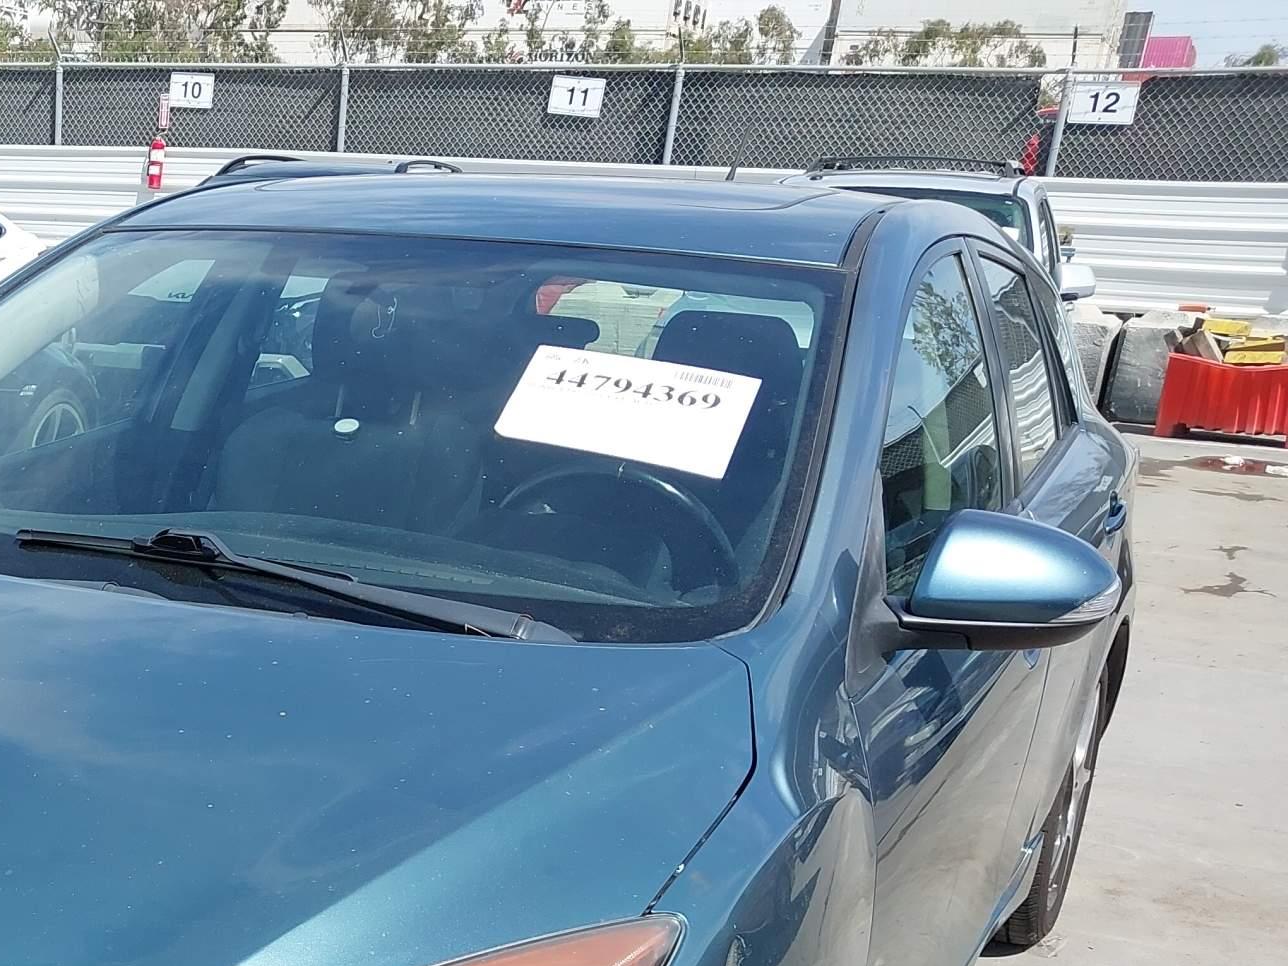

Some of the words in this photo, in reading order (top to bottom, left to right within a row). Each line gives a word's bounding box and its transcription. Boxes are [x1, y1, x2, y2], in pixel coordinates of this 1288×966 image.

[181, 81, 202, 99] 10
[566, 86, 590, 107] 11
[1089, 91, 1121, 113] 12
[546, 369, 722, 410] 44794369
